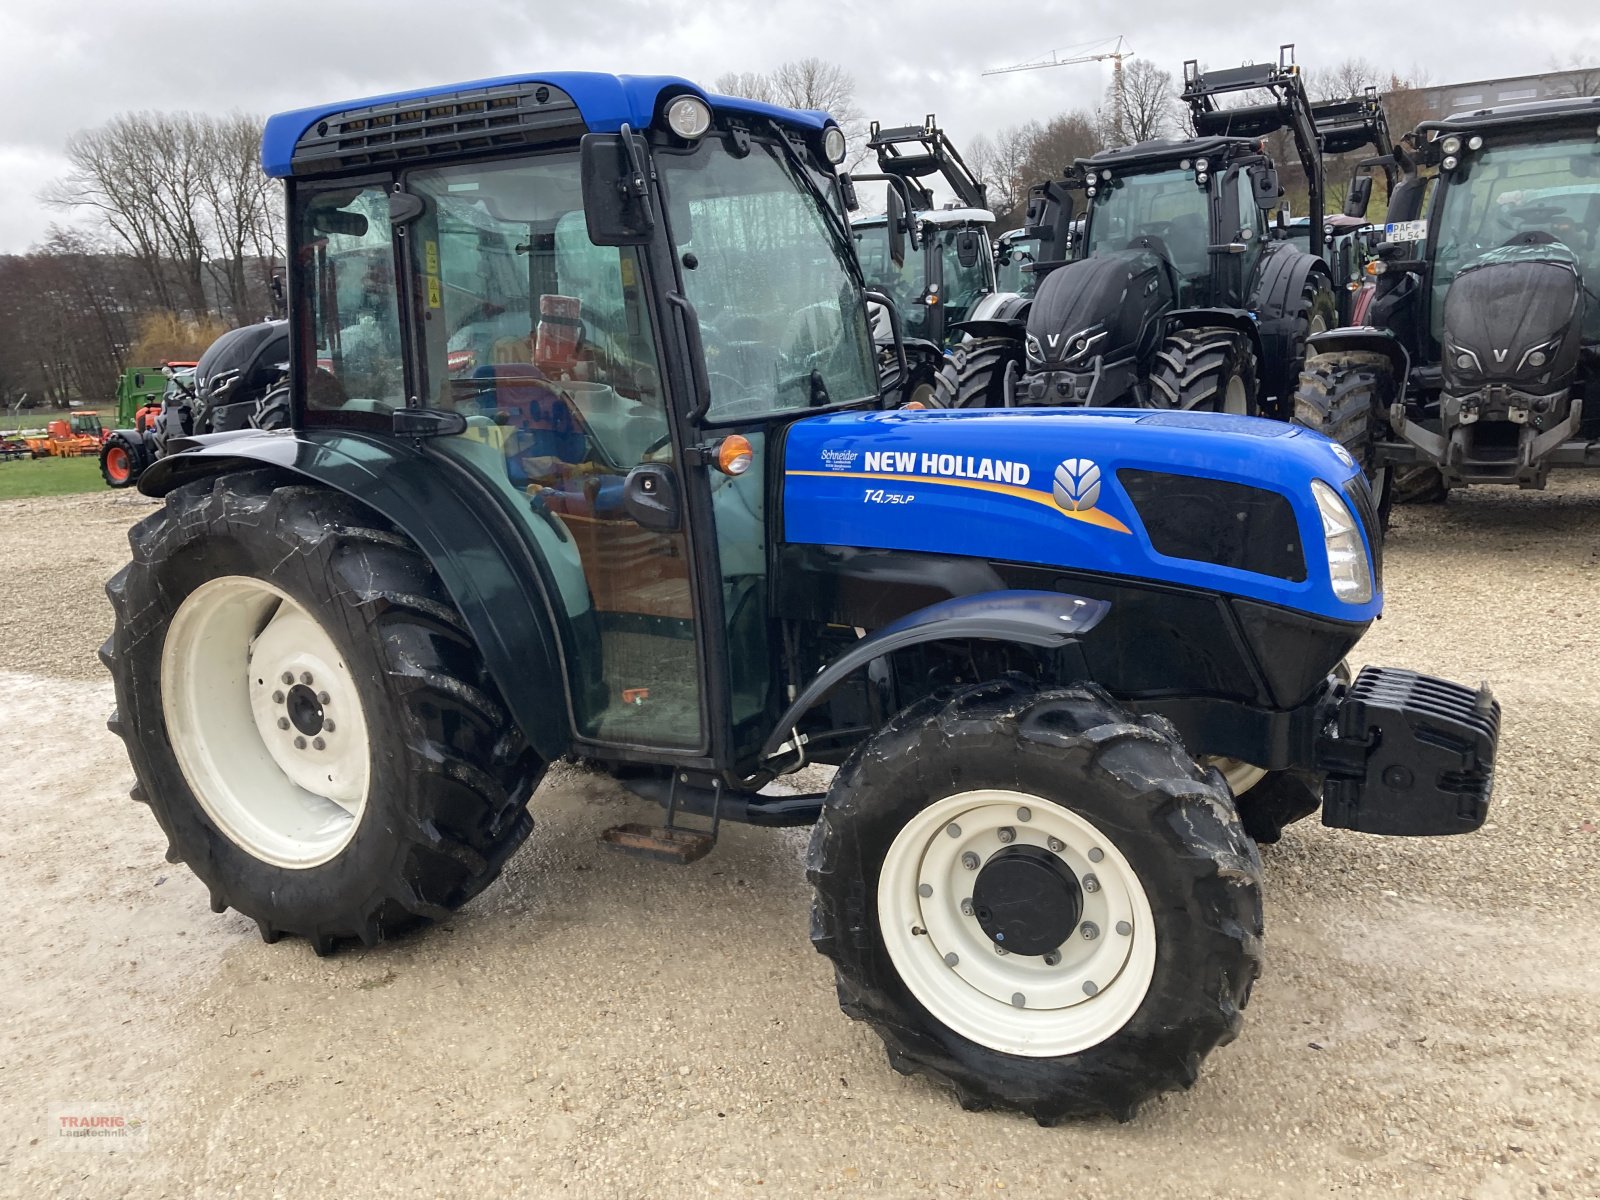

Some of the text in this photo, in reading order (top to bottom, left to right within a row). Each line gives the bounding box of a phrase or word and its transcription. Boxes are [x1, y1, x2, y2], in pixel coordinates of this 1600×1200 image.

[1393, 223, 1412, 232] PAF
[1393, 231, 1419, 241] EL 54
[821, 449, 858, 461] Schneider
[864, 451, 1031, 486] NEW HOLLAND
[863, 489, 915, 504] T4.75LP
